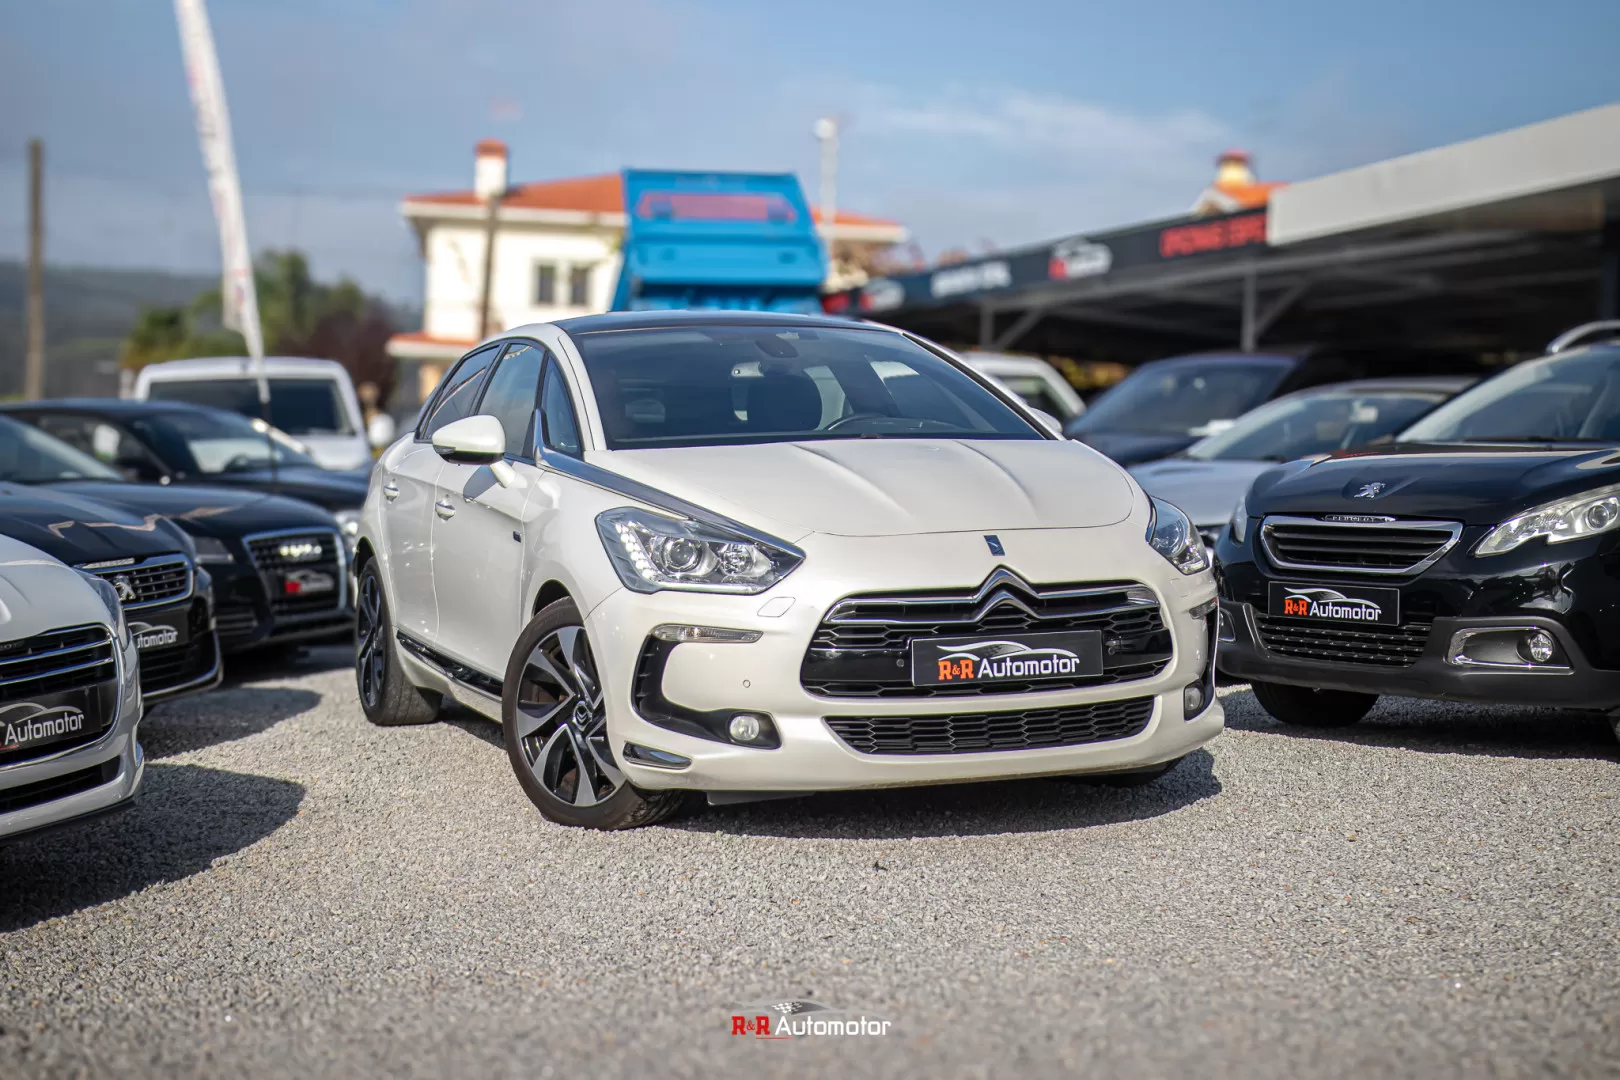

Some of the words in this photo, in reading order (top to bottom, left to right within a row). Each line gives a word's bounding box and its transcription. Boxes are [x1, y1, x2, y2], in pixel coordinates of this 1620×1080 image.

[1284, 599, 1307, 616] R&R
[1309, 601, 1382, 621] Automotor
[137, 629, 178, 648] tomotor
[938, 659, 975, 681] R&R
[977, 654, 1081, 679] Automotor
[4, 711, 85, 746] Automotor
